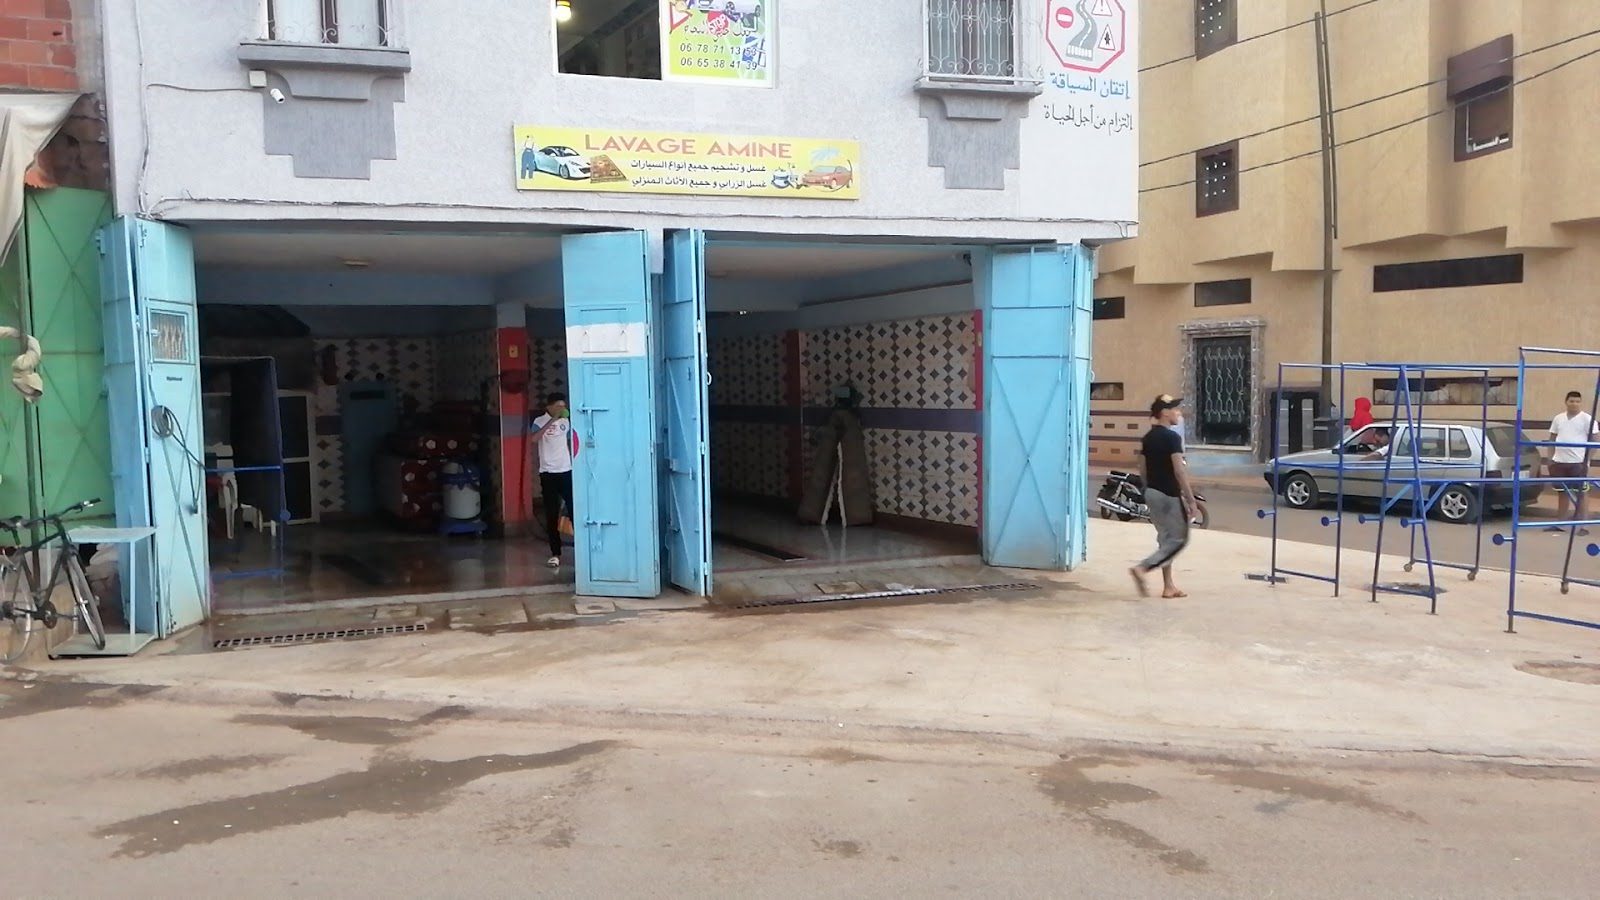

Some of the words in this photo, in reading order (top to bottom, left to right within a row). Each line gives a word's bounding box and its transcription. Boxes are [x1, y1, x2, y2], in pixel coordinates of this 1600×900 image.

[680, 43, 692, 52] 06
[697, 44, 709, 53] 78
[713, 45, 724, 54] 71
[730, 47, 741, 56] 13
[680, 57, 692, 67] 06
[697, 58, 709, 68] 65
[713, 59, 725, 68] 38
[730, 60, 741, 69] 41
[1050, 72, 1097, 94] السياقة
[1094, 115, 1106, 129] من
[585, 134, 696, 155] LAVAGE
[707, 141, 792, 159] AMINE
[631, 159, 667, 170] السيارات
[688, 164, 709, 173] جميع
[746, 164, 766, 173] غسل
[632, 176, 664, 187] المنزلي
[689, 179, 711, 189] جميع
[719, 179, 746, 190] الزرابي
[746, 179, 767, 189] غسل
